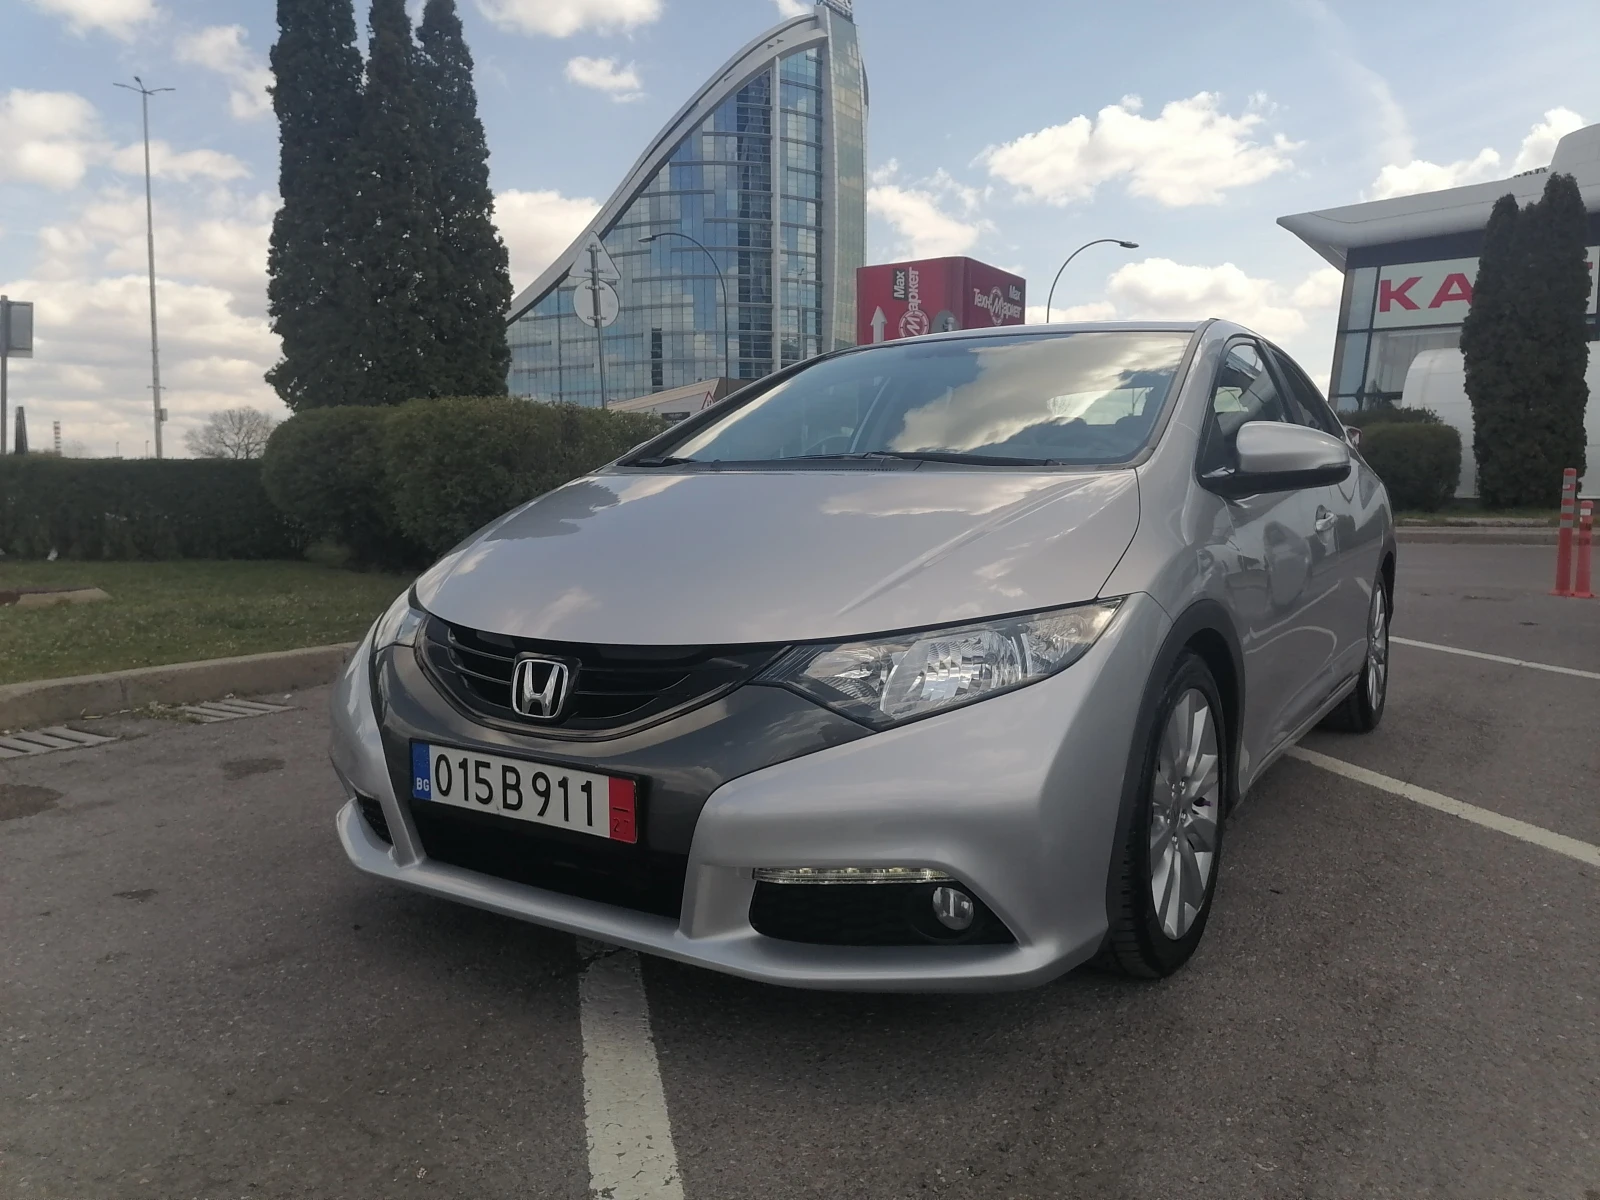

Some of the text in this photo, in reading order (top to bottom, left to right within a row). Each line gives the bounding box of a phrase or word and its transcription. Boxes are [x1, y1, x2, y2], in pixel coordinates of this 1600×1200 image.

[893, 270, 905, 299] Max
[416, 777, 430, 792] BG
[435, 753, 593, 827] 015B911
